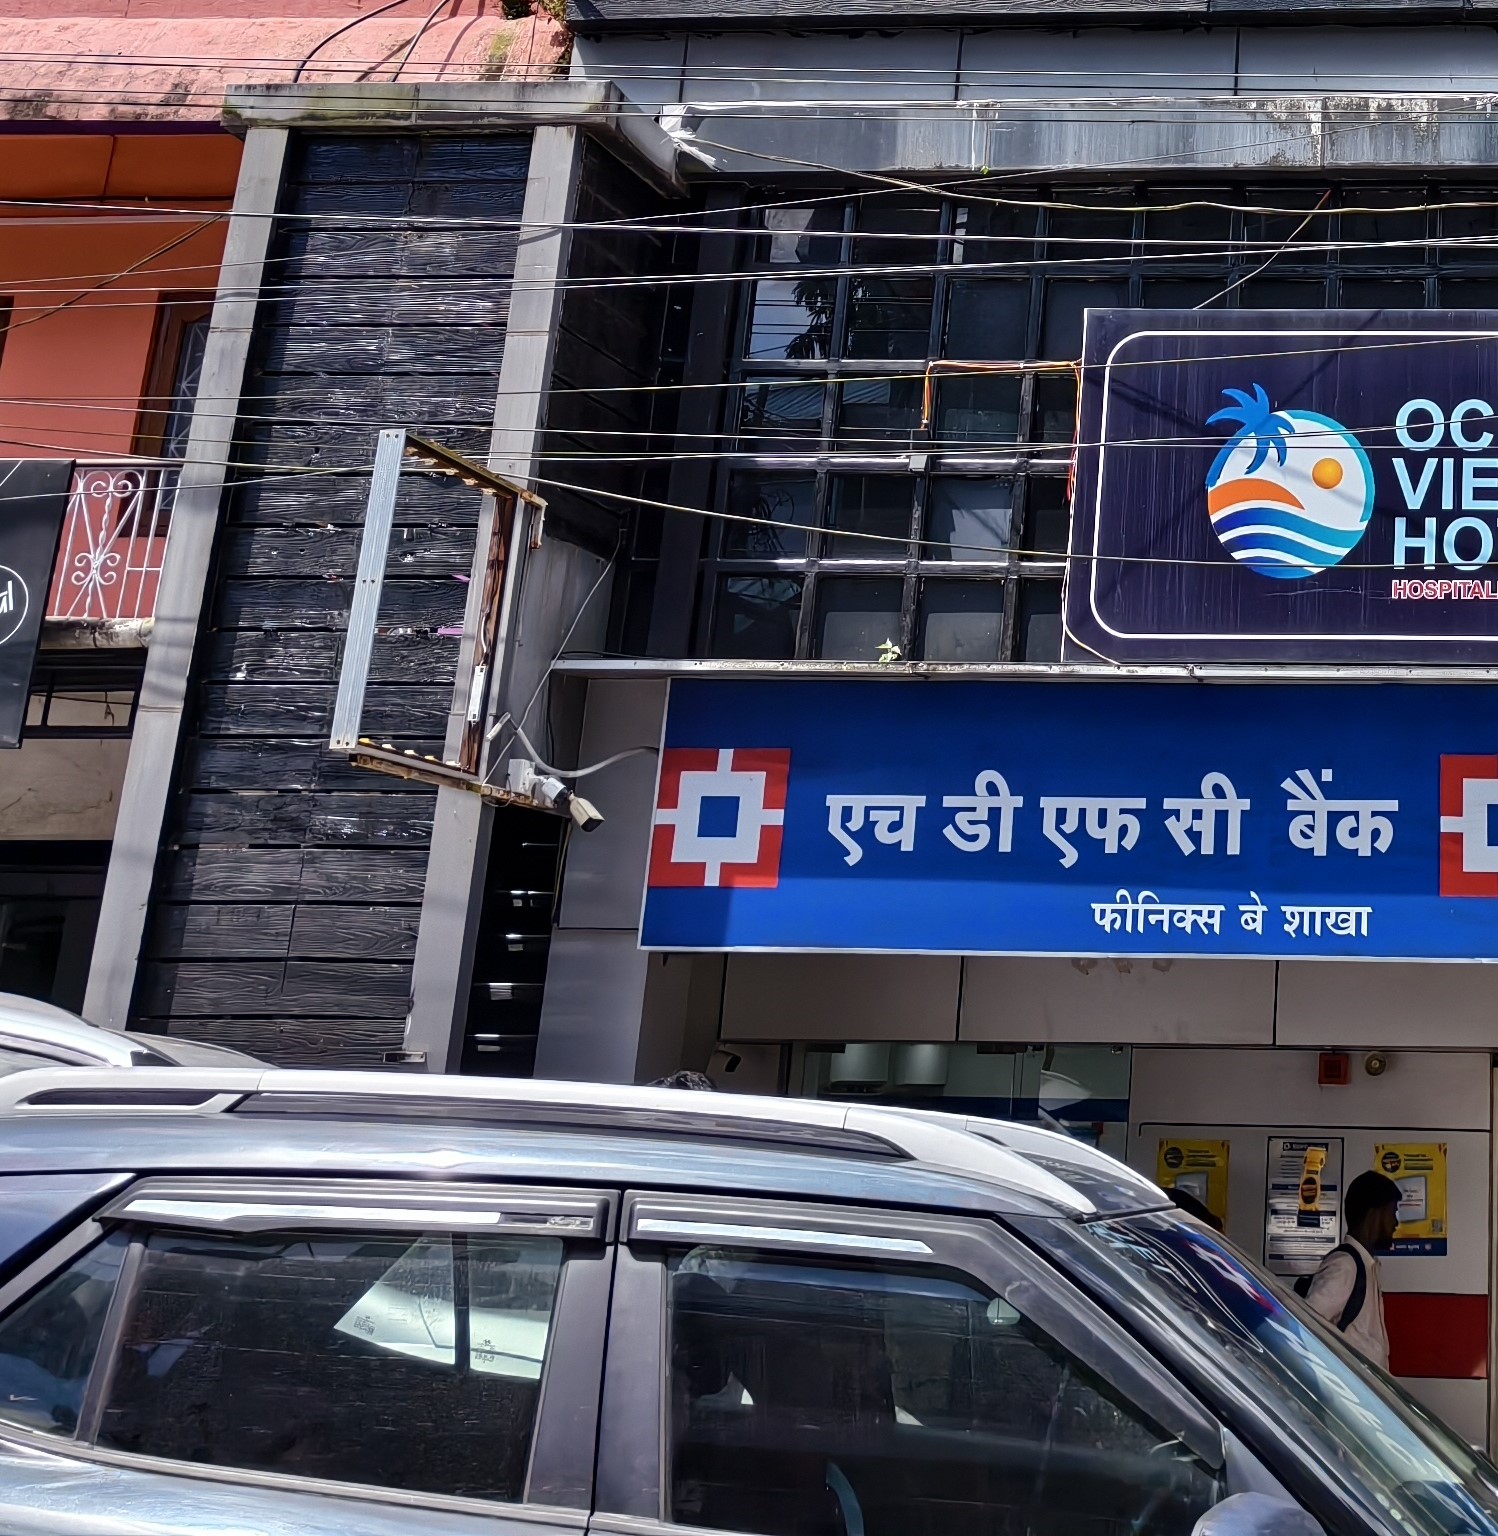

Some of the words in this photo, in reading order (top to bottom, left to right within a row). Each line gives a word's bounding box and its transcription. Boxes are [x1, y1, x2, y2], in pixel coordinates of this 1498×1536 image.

[825, 794, 927, 867] एच
[942, 769, 1024, 853] डी
[1039, 796, 1147, 869] एफ
[1162, 771, 1251, 857] सी
[1280, 768, 1400, 857] बैंक
[1090, 888, 1226, 935] फीनिक्स
[1238, 890, 1269, 935] बे
[1280, 905, 1374, 938] शाखा
